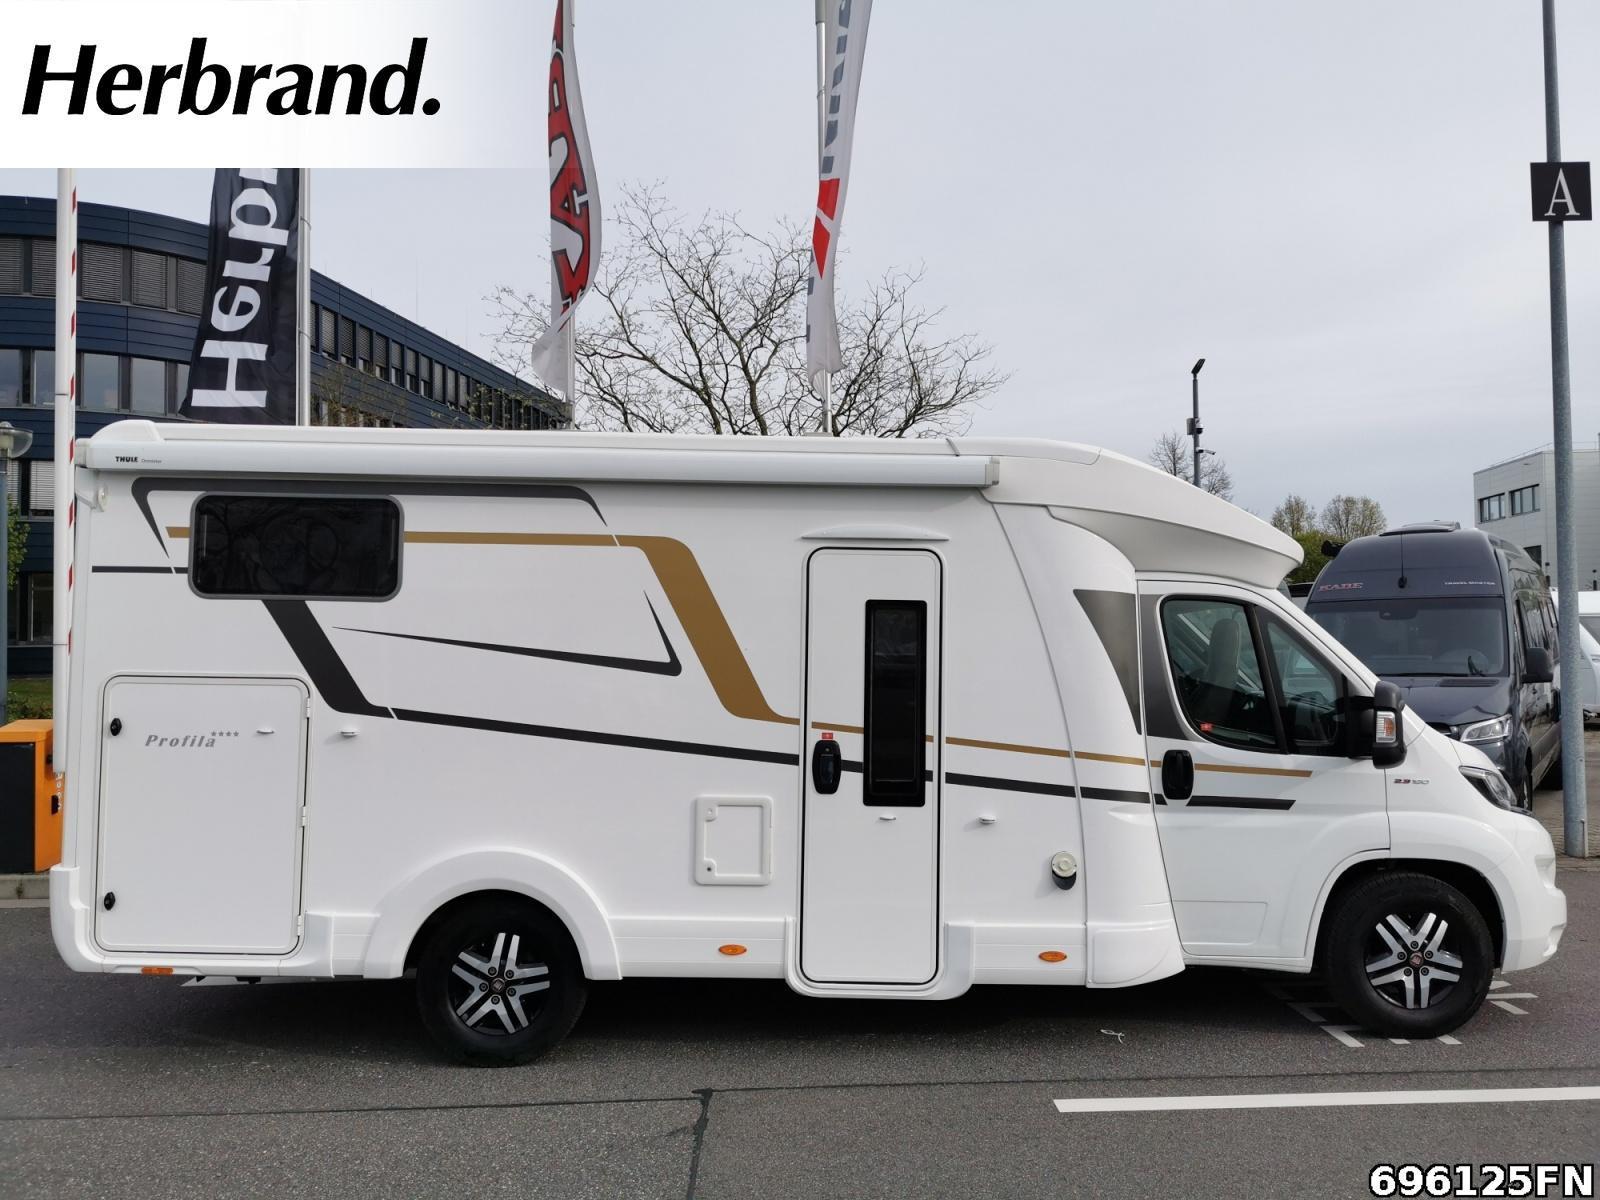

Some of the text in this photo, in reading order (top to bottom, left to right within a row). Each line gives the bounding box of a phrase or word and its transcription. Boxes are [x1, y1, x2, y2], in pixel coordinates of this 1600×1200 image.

[1544, 167, 1581, 216] A
[1318, 582, 1364, 593] KABE
[145, 734, 216, 748] Profila
